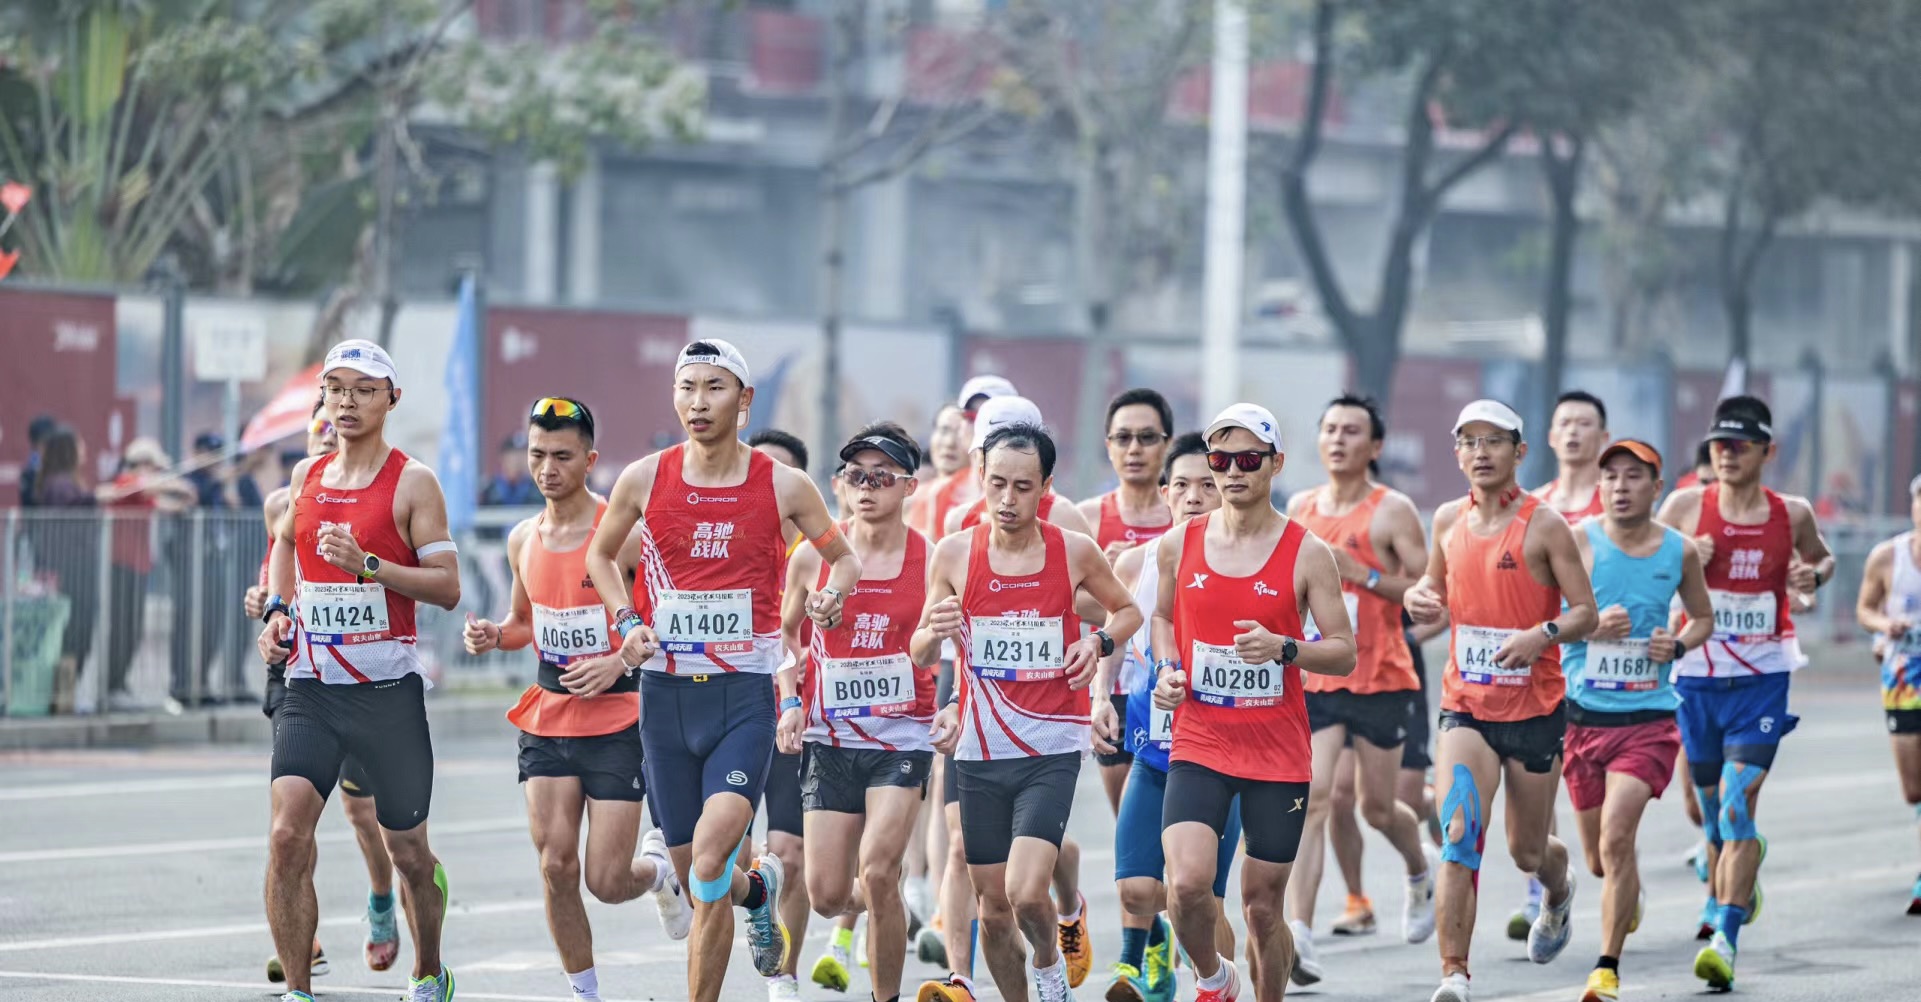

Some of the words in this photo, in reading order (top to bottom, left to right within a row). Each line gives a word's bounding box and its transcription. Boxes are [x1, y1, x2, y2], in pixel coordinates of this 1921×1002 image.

[692, 521, 735, 540] 高驰
[690, 540, 729, 559] 战队
[1001, 581, 1040, 589] COROS
[311, 605, 375, 627] A1424
[669, 613, 739, 635] A1402
[853, 612, 891, 631] 高驰
[542, 626, 597, 649] A0665
[850, 631, 885, 649] 战队
[714, 643, 745, 652] 农夫山泉
[983, 639, 1051, 662] A2314
[1026, 671, 1055, 679] 农夫山泉
[1201, 666, 1270, 690] A0280
[834, 676, 901, 701] B0097
[1244, 698, 1274, 707] 农夫山泉
